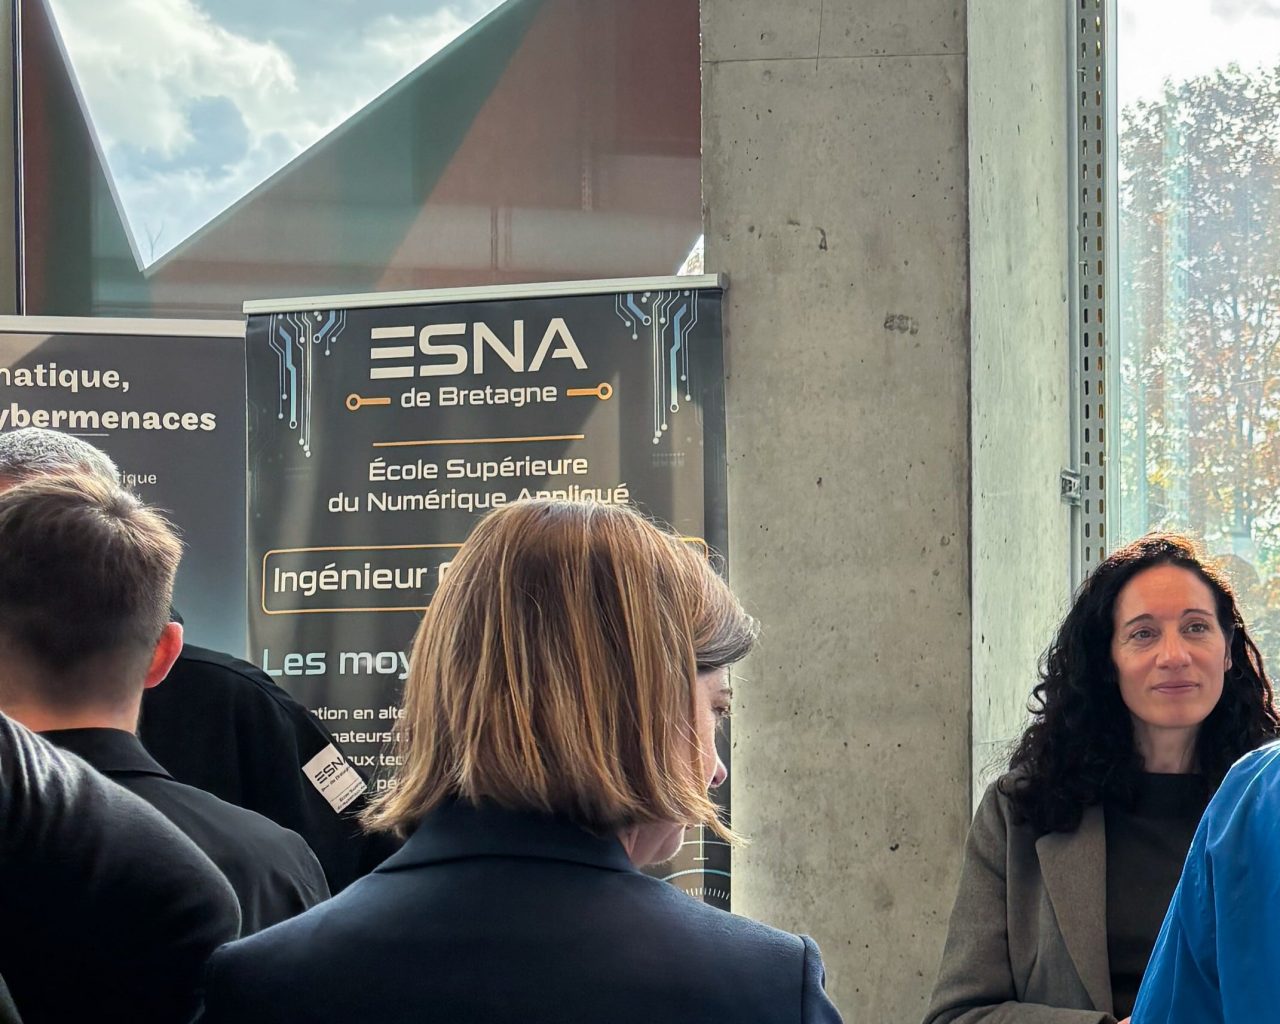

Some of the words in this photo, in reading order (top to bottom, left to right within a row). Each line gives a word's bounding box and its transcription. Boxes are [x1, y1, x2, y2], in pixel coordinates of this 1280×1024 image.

[370, 317, 588, 380] ESNA
[400, 387, 431, 409] de
[439, 385, 558, 408] Bretagne
[368, 457, 439, 482] École
[446, 456, 588, 482] Supérieure
[328, 492, 359, 513] du
[367, 488, 507, 513] Numérique
[274, 562, 428, 597] Ingénieur
[263, 648, 326, 677] Les
[353, 709, 374, 720] en
